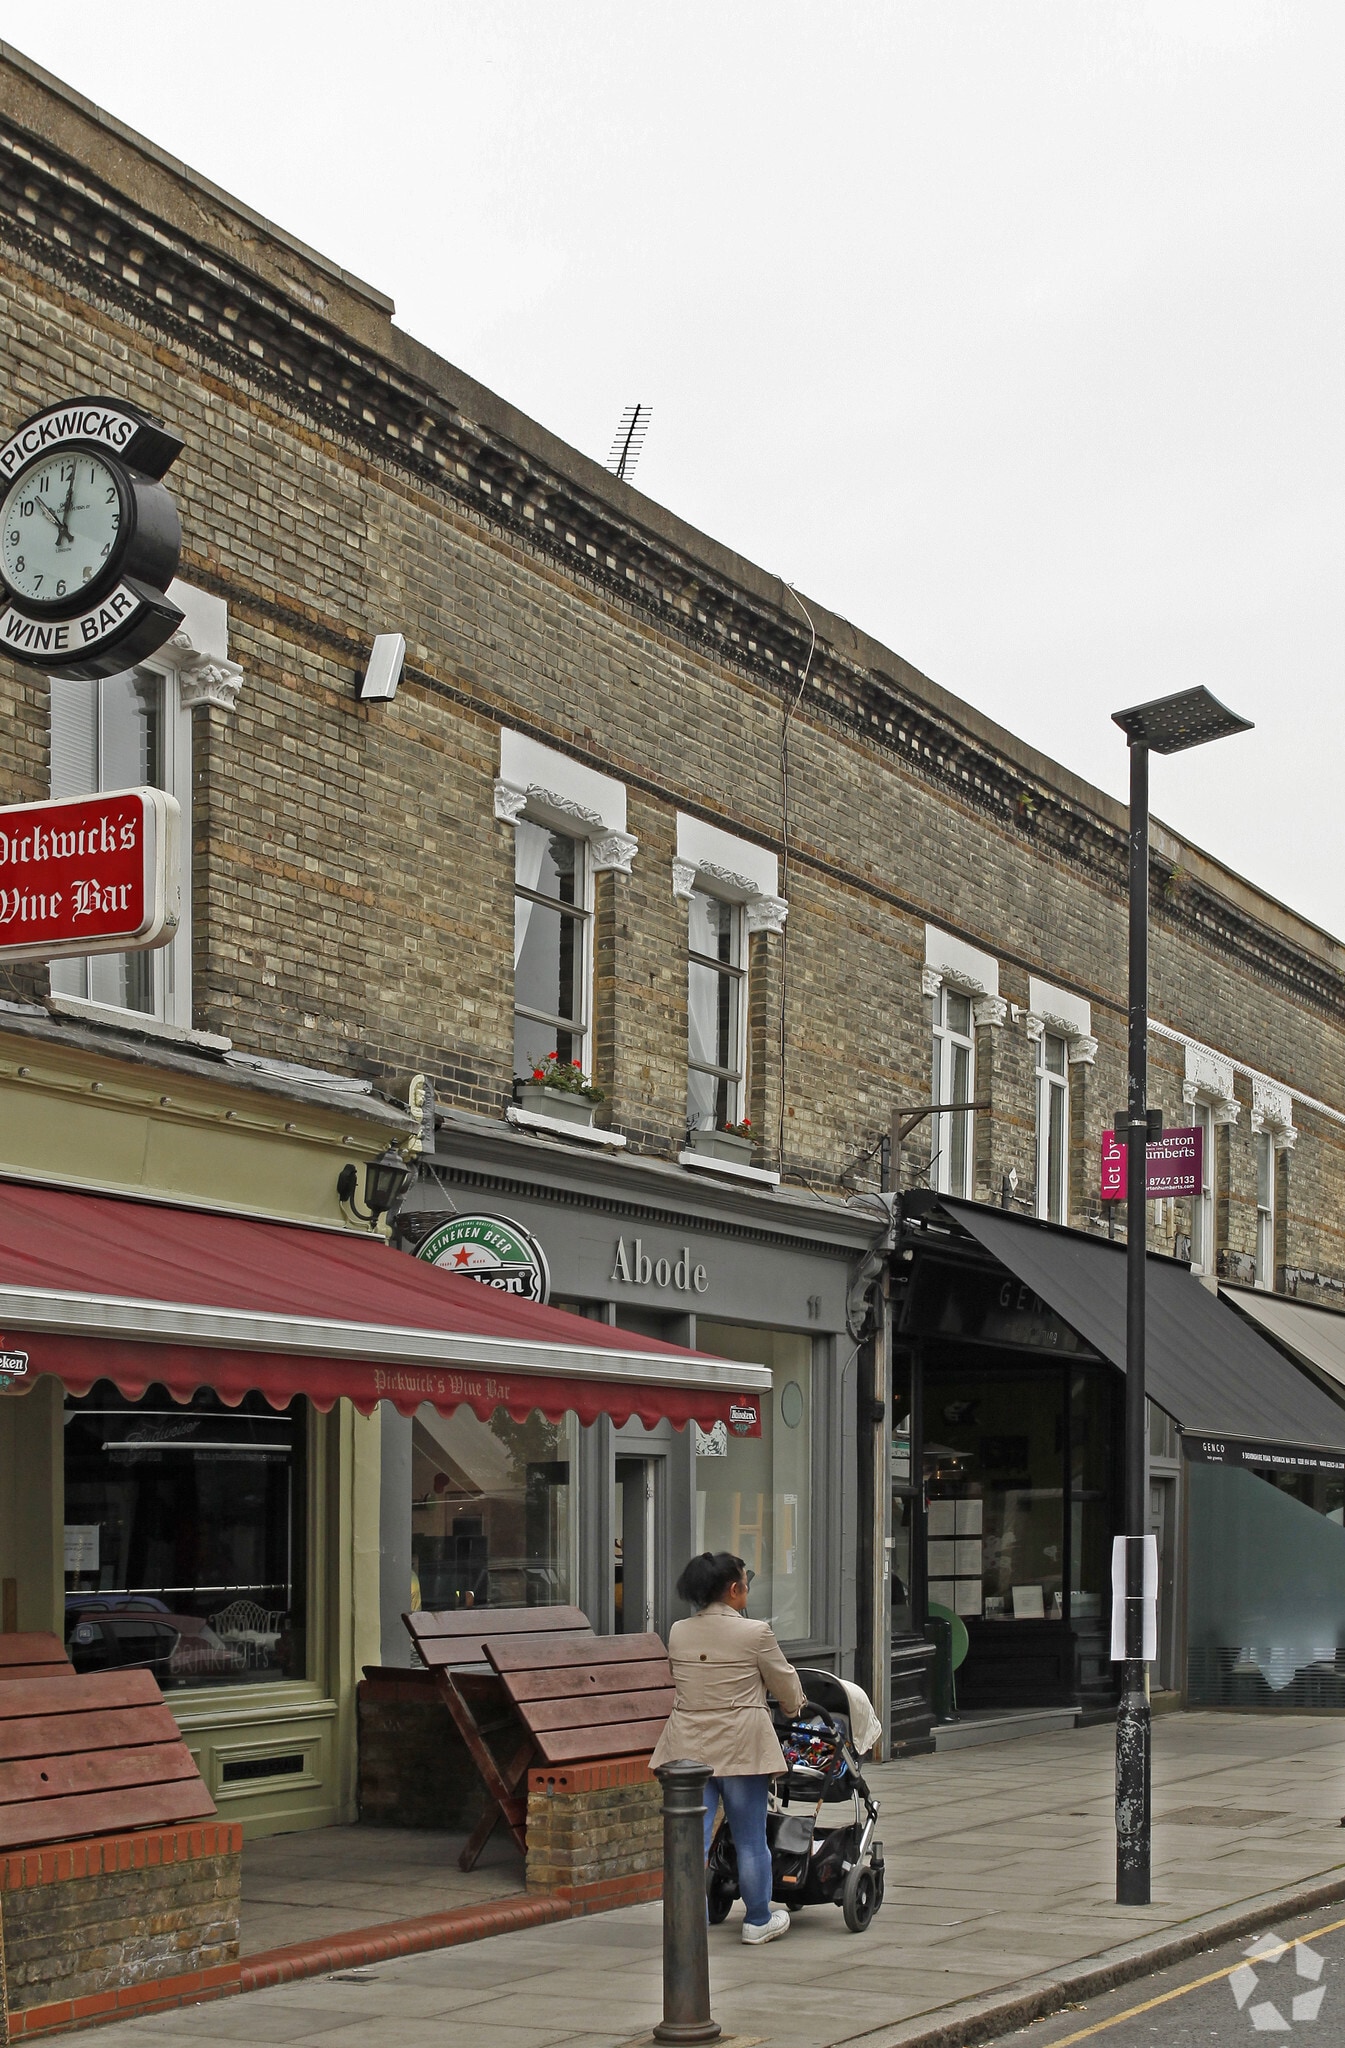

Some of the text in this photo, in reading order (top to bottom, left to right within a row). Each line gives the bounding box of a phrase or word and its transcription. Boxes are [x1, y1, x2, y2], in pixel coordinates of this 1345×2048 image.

[1, 411, 132, 473] PICKWICKS
[60, 464, 75, 482] 12
[40, 476, 50, 493] 11
[106, 487, 116, 505] 2
[19, 501, 34, 518] 10
[111, 514, 120, 530] 3
[10, 530, 20, 547] 9
[100, 542, 111, 558] 4
[15, 556, 26, 573] 8
[33, 574, 44, 592] 7
[56, 580, 67, 597] 6
[5, 592, 133, 650] WINE BAR
[71, 878, 133, 923] Bar
[1146, 1146, 1195, 1159] umberts
[1104, 1166, 1121, 1190] let
[1149, 1175, 1195, 1186] 8747 3133
[425, 1227, 513, 1260] HEINEKEN BEER
[611, 1235, 710, 1293] Abode
[999, 1281, 1044, 1314] GEN
[374, 1368, 511, 1400] Pickwick's Wine Bar
[1202, 1442, 1225, 1453] GENCO
